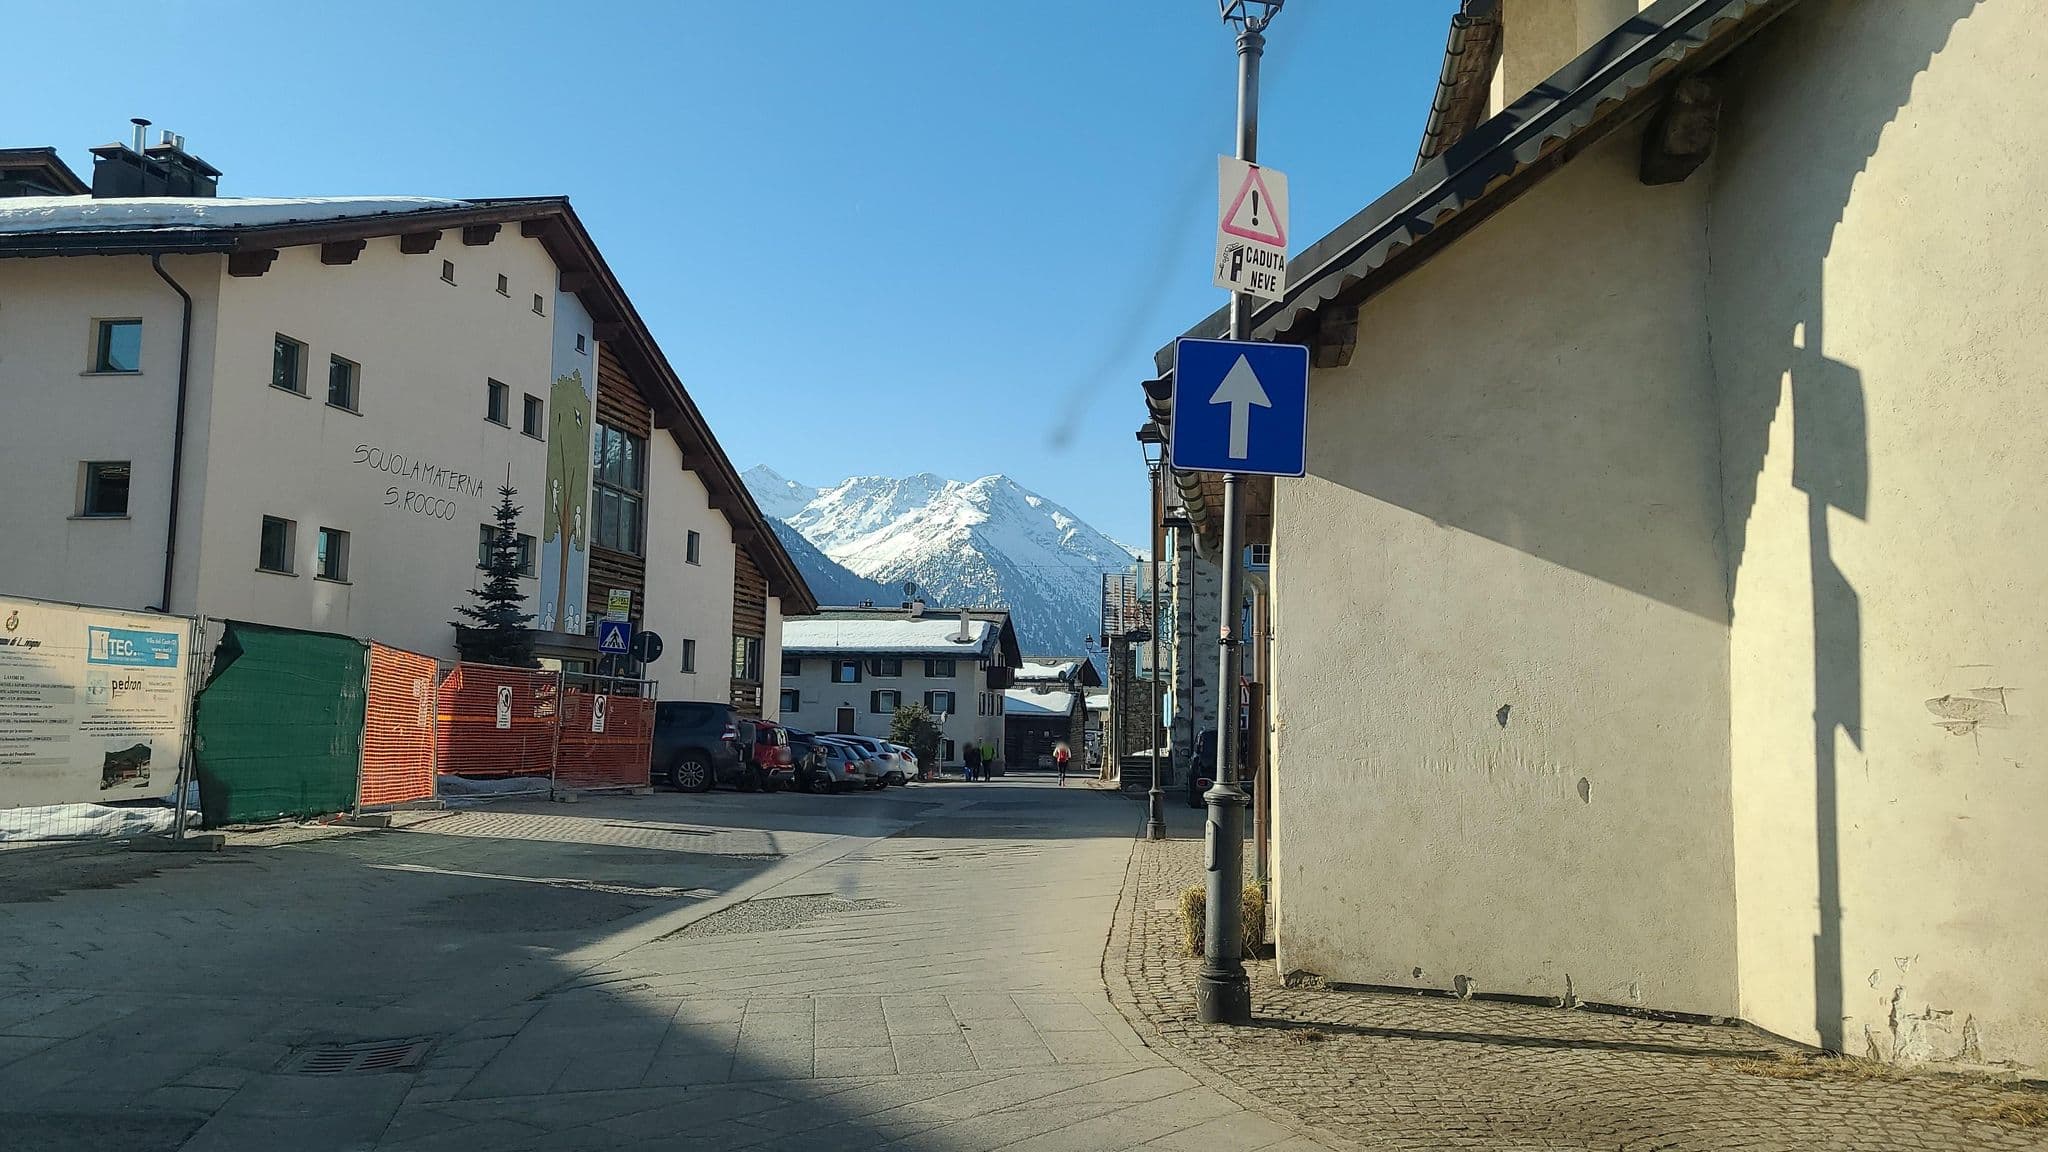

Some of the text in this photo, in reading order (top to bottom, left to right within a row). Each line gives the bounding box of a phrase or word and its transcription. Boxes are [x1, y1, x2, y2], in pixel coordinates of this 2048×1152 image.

[1246, 246, 1285, 272] CADUTA
[1251, 270, 1277, 292] NEVE
[353, 444, 483, 499] SCUOLA MATERNA
[111, 675, 143, 700] pedron
